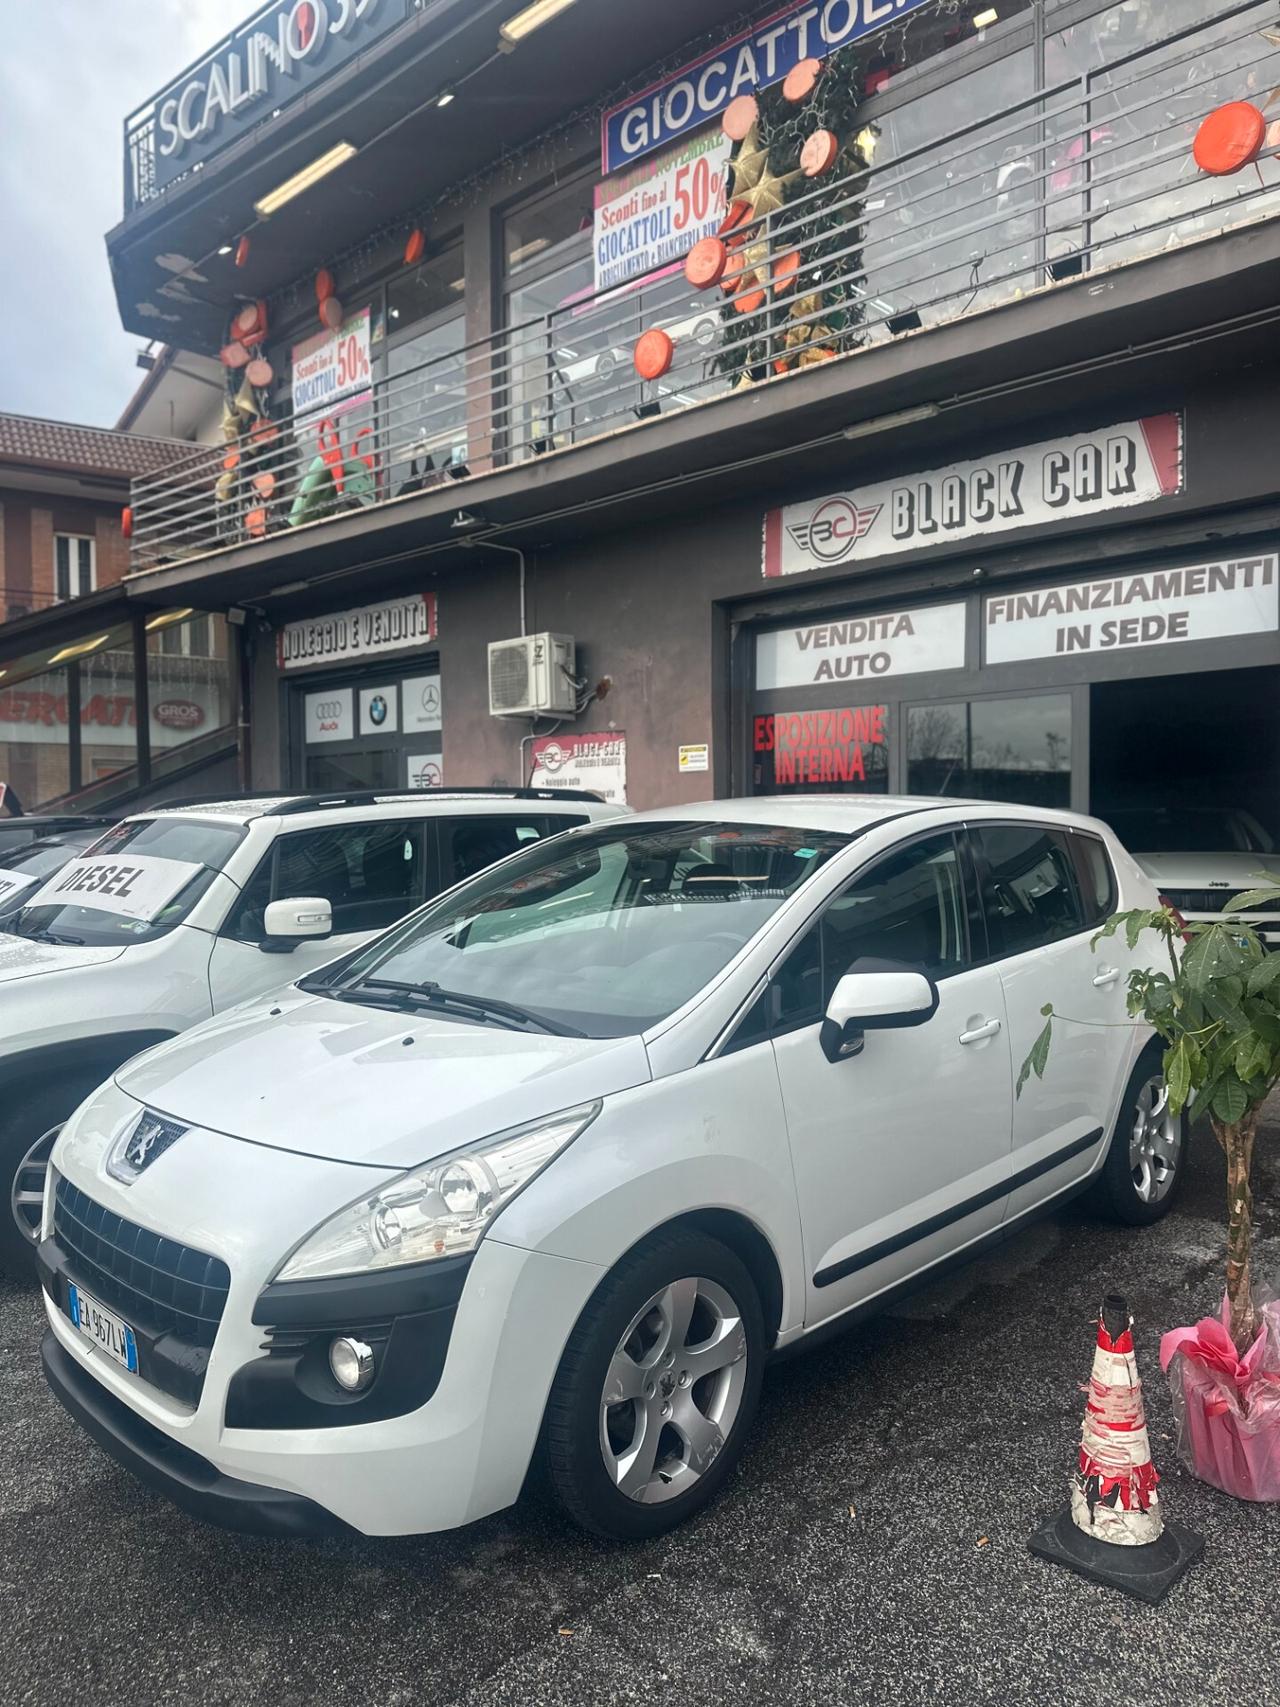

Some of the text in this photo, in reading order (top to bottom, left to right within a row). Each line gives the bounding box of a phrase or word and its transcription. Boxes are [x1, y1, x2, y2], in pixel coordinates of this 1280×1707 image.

[620, 0, 906, 154] GIOCATTOL
[601, 191, 639, 231] Sconti
[641, 189, 658, 212] fino
[659, 181, 667, 204] al
[598, 206, 671, 266] GIOCATTOLI
[337, 335, 369, 387] 50%
[891, 460, 1024, 541] BLACK
[1042, 436, 1136, 507] CAR
[988, 557, 1274, 625] FINANZIAMENTI
[283, 601, 429, 660] NOLEGGIO E VENDITA
[795, 614, 915, 651] VENDITA
[1056, 611, 1190, 653] IN SEDE
[813, 652, 891, 682] AUTO
[158, 704, 199, 717] GROS
[320, 720, 339, 732] Audi
[754, 704, 886, 752] ESPOSIZIONE
[775, 743, 865, 784] INTERNA
[55, 865, 144, 898] DIESEL
